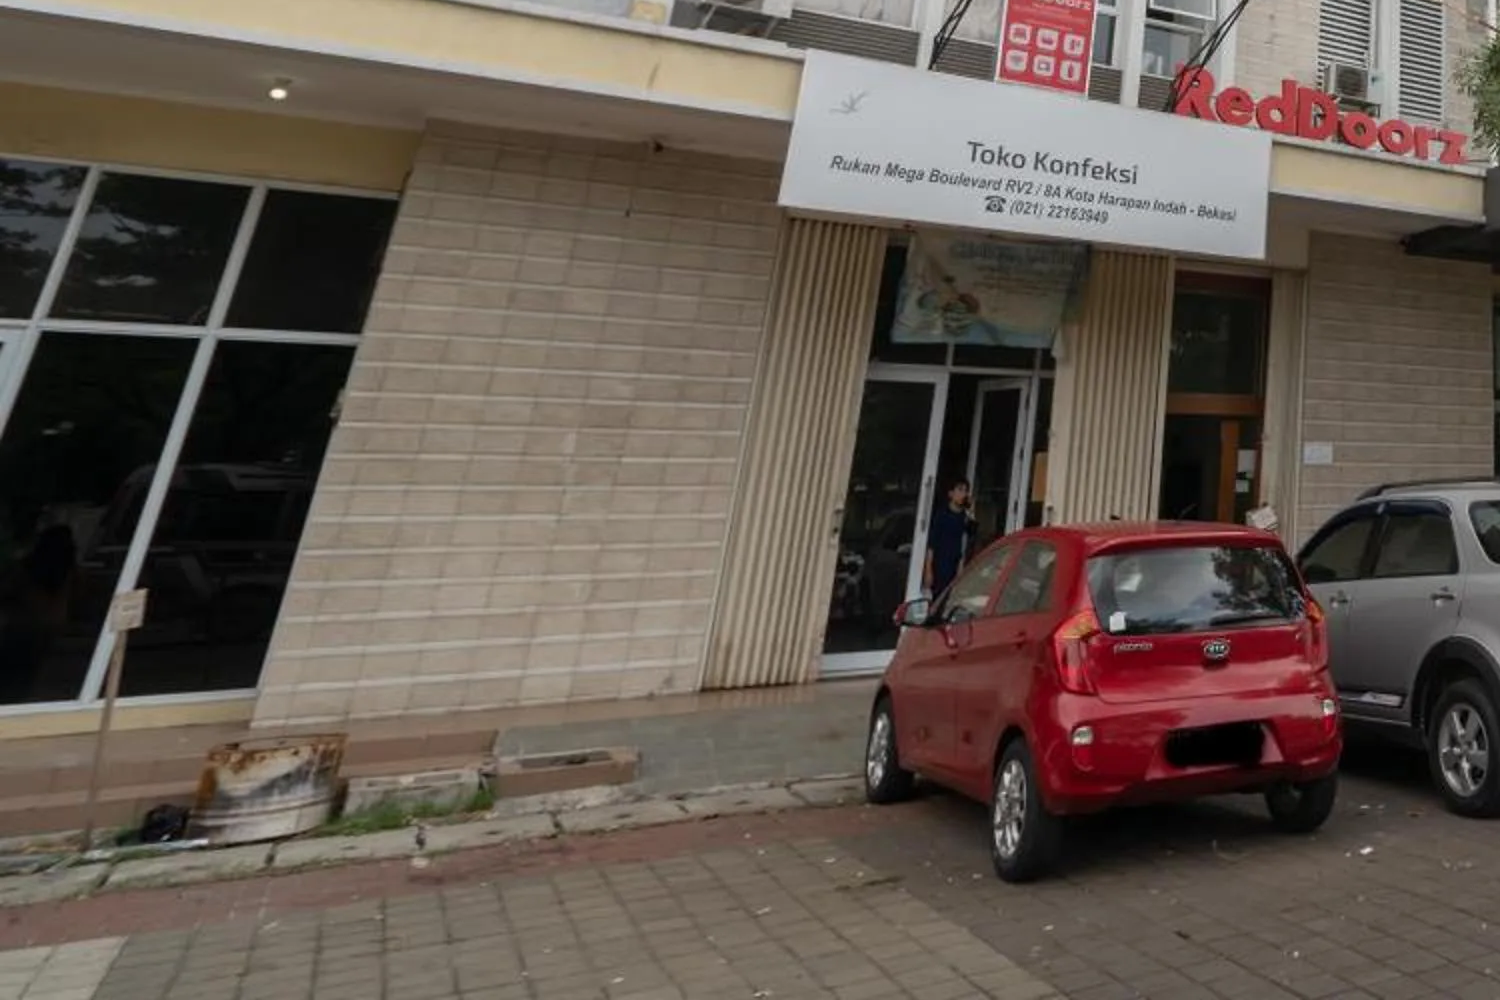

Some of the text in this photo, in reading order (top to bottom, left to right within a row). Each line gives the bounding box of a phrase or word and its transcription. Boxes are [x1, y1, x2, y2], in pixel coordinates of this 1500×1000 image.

[1173, 61, 1470, 165] RedDoorz
[830, 155, 880, 176] Rukan
[884, 162, 925, 183] Mega
[929, 168, 1001, 191] Boulevard
[1004, 179, 1033, 196] RV2
[1044, 184, 1061, 199] 8A
[1065, 187, 1095, 204] Kota
[1097, 191, 1150, 211] Harapan
[1152, 199, 1187, 216] Indah
[967, 140, 1139, 185] Toko Konfeksi
[1010, 201, 1044, 218] (021)
